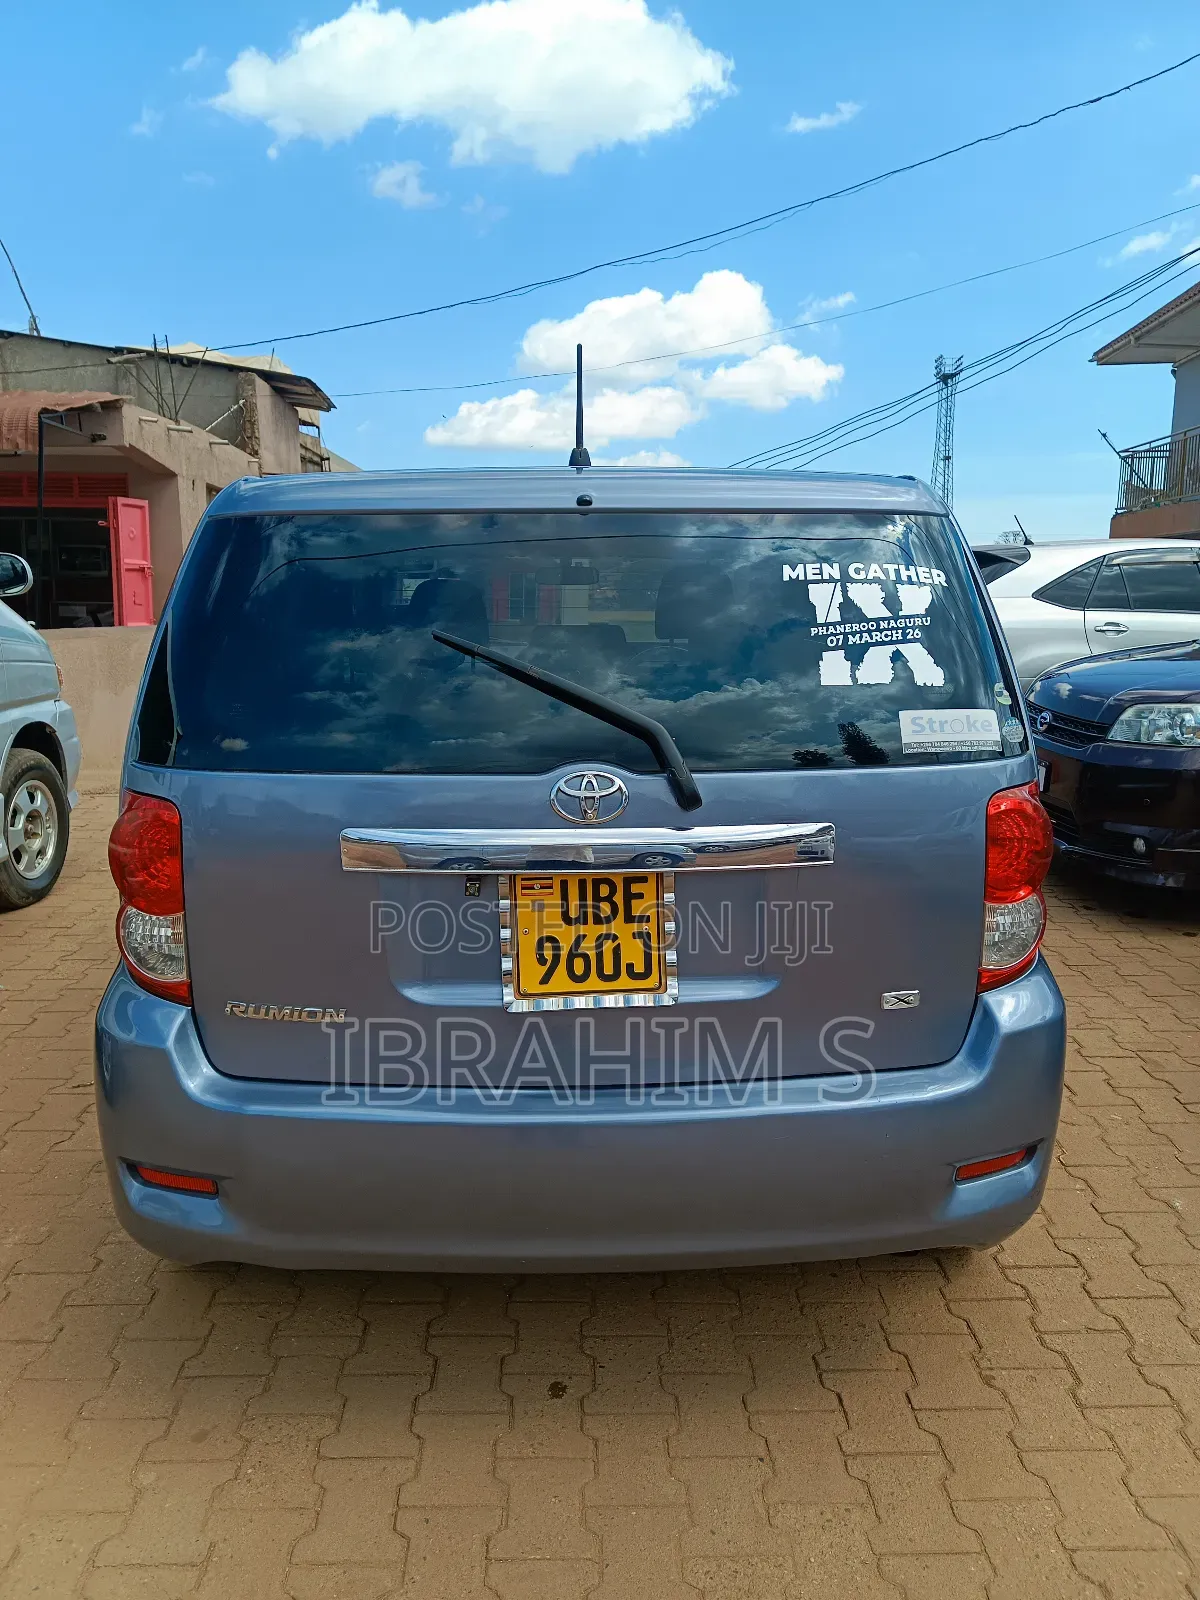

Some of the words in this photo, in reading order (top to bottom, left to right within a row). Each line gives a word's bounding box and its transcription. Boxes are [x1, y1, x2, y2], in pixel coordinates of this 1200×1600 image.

[782, 562, 841, 581] MEN
[847, 563, 948, 587] GATHER
[810, 621, 877, 636] PHANEROO
[879, 616, 931, 630] NAGURU
[826, 635, 844, 647] 07
[847, 629, 903, 645] MARCH
[906, 628, 922, 639] 26
[910, 714, 993, 734] Stroke
[559, 875, 651, 926] UBE
[535, 931, 653, 985] 960J
[225, 1000, 347, 1023] RUMION
